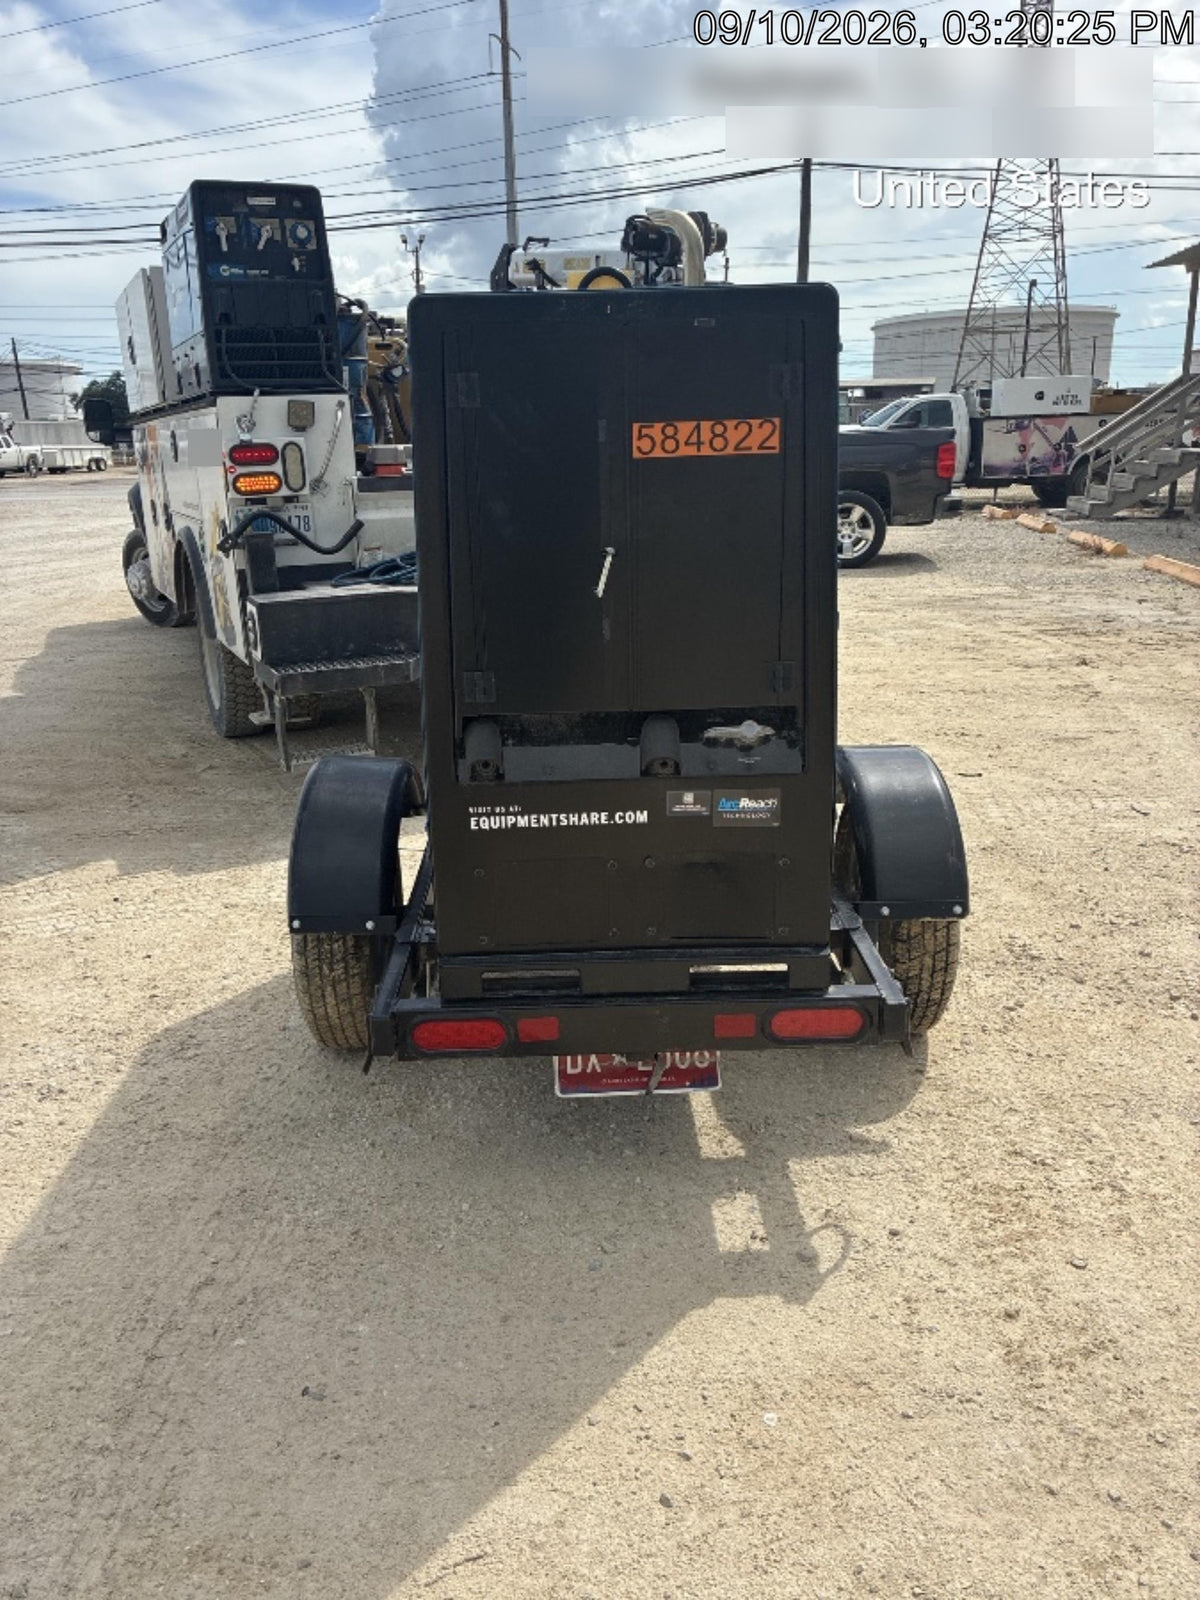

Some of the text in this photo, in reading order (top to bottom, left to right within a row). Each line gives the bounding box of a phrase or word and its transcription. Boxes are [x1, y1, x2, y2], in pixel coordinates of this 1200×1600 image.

[635, 418, 778, 456] 584822
[468, 806, 492, 814] VISIT
[717, 797, 778, 811] ArcReach
[469, 809, 649, 831] EQUIPMENTSHARE.COM
